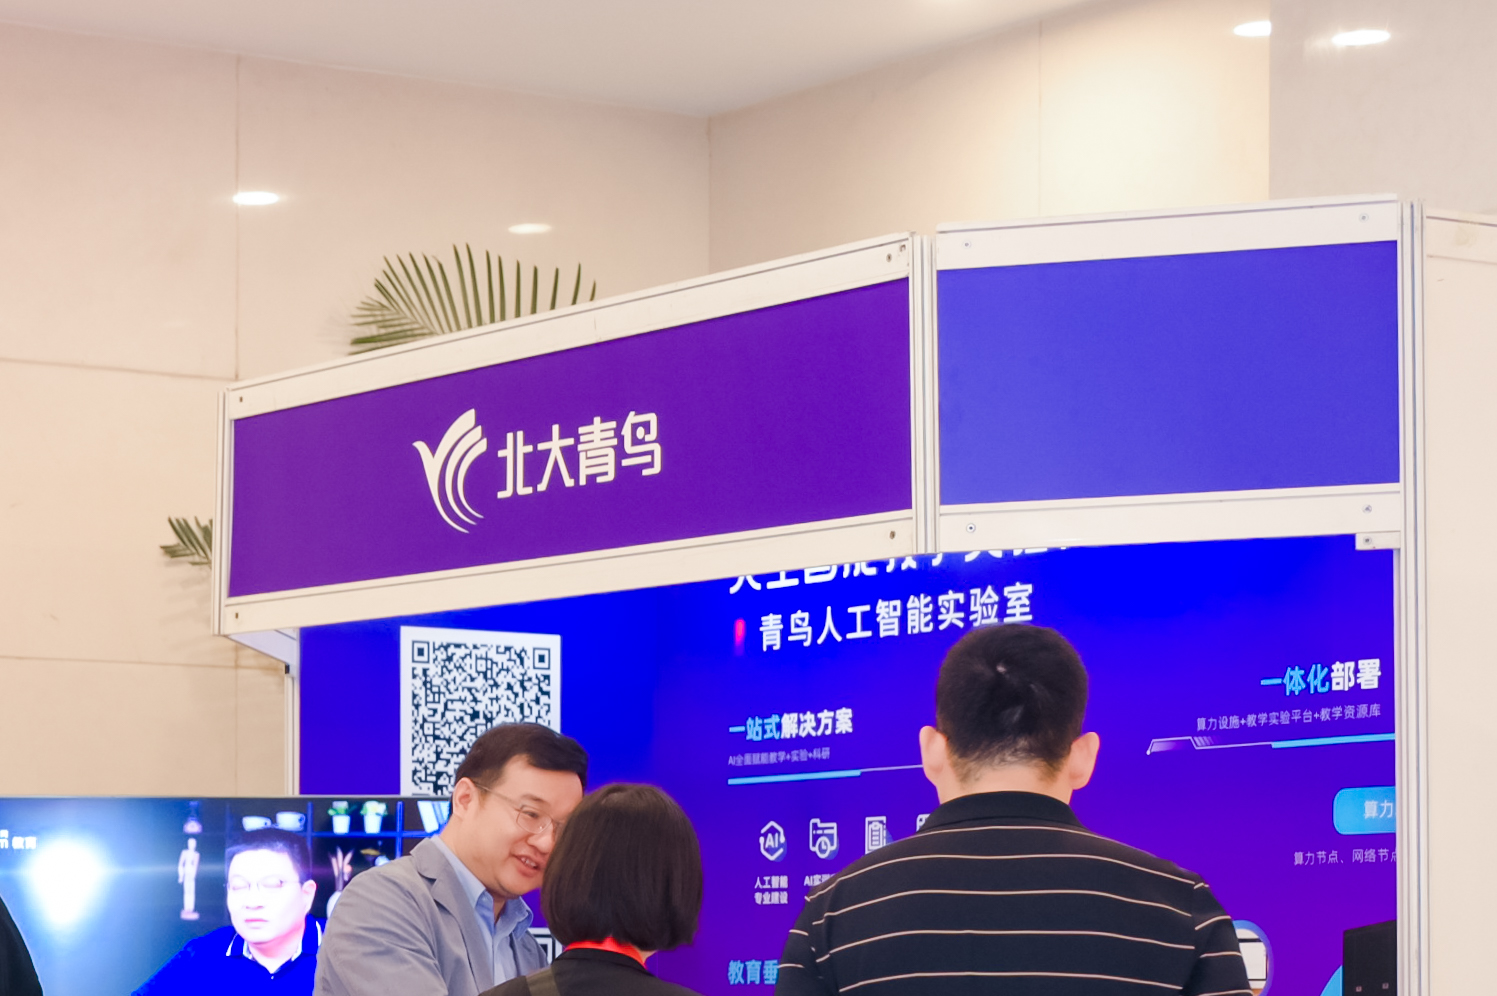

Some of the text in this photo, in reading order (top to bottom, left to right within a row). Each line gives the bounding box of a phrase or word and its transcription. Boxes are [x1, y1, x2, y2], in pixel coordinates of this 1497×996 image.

[497, 410, 662, 499] 北大青鸟
[759, 582, 1034, 652] 青鸟人工智能实验室
[1260, 658, 1382, 696] 一体化部署
[729, 707, 853, 741] 一站式解决方案
[1196, 703, 1382, 732] 算力设施+教学实验平台+教学资源库
[1364, 800, 1396, 819] 算力
[754, 875, 789, 889] 人工智能
[727, 959, 779, 985] 教育垂
